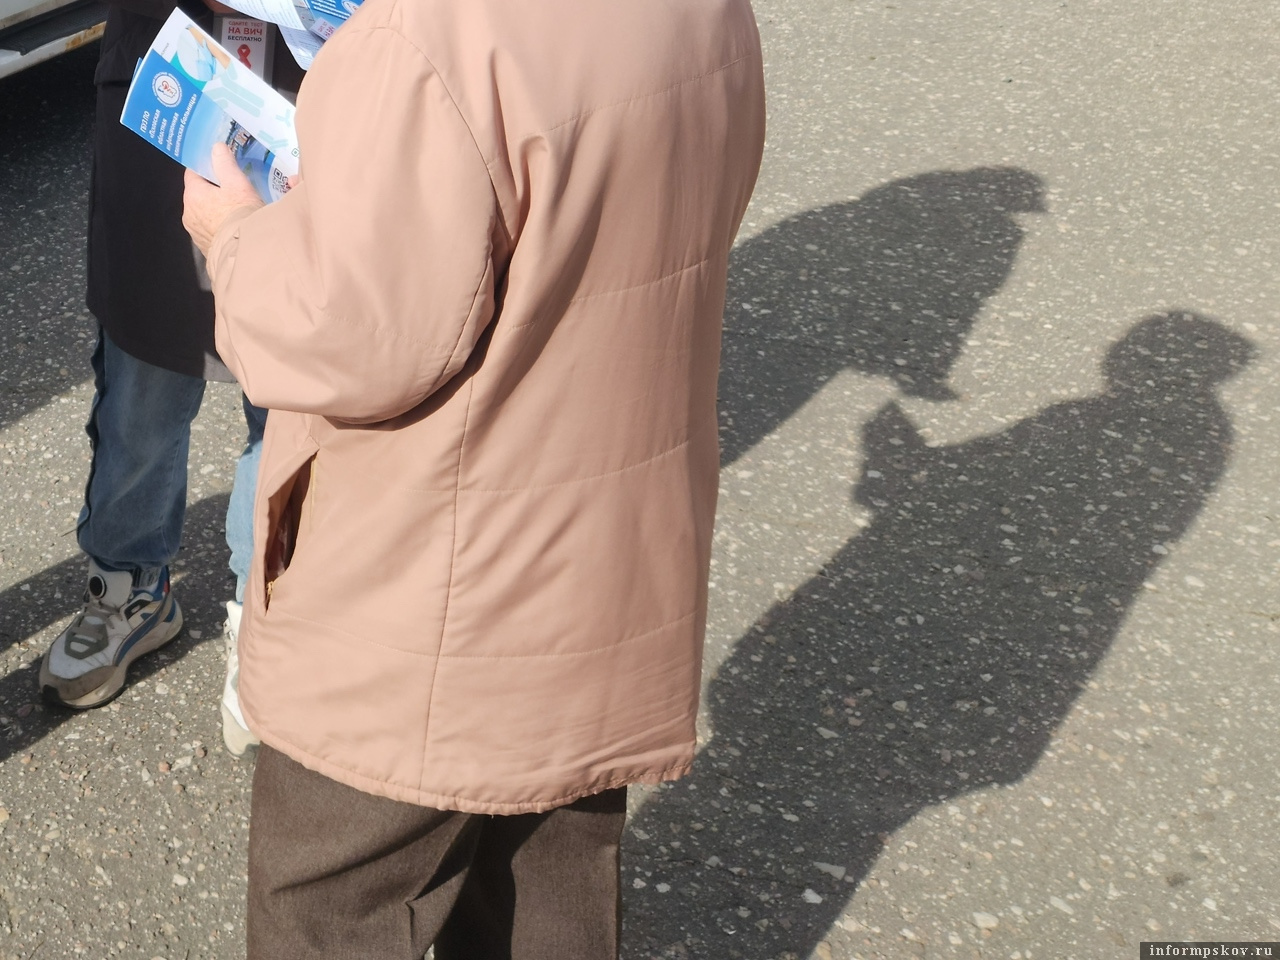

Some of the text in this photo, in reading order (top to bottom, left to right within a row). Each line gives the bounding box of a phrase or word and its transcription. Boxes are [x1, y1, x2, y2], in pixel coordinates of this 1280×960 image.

[228, 26, 263, 36] НА ВИЧ
[227, 34, 263, 43] БЕСПЛАТНО
